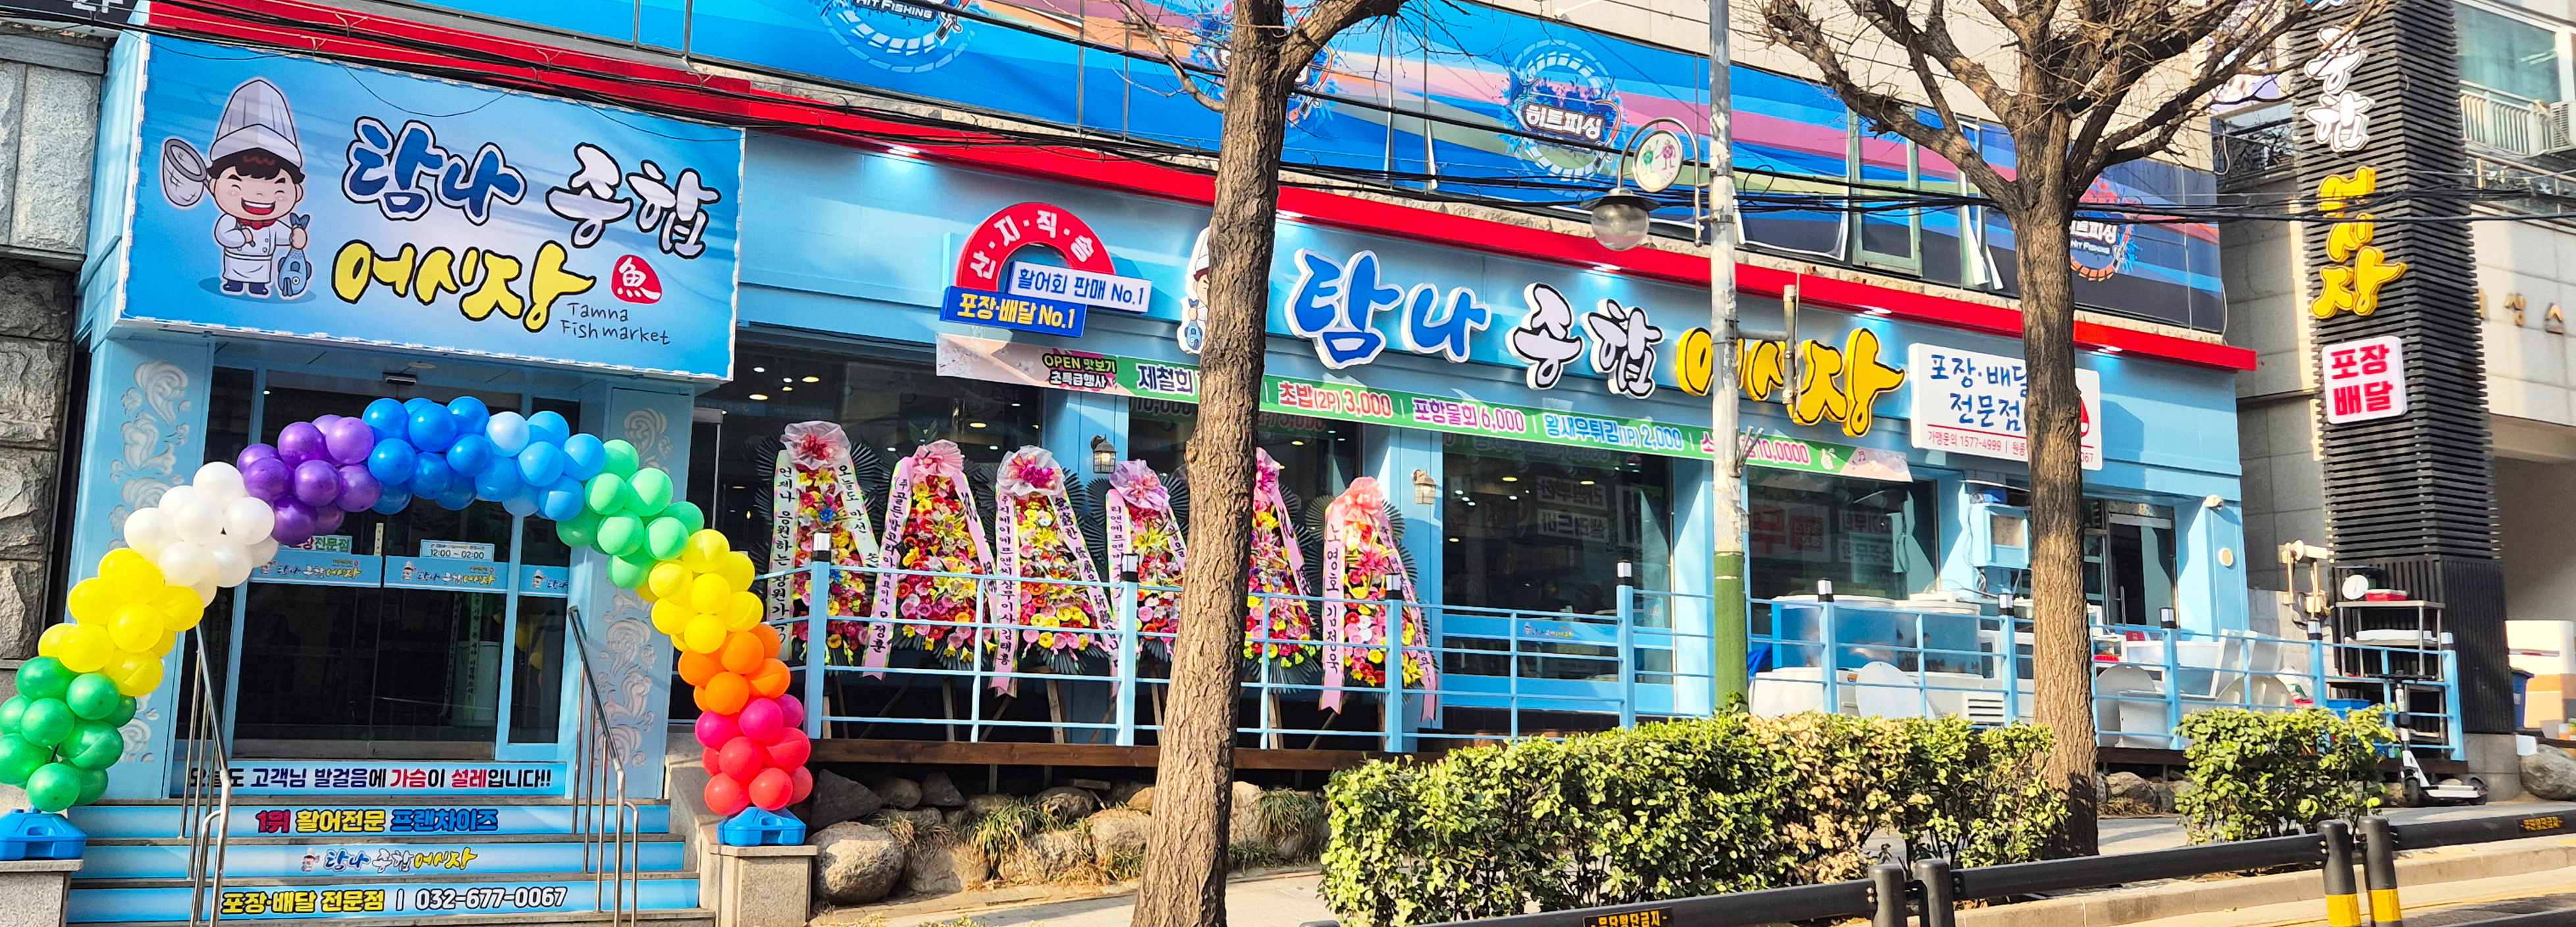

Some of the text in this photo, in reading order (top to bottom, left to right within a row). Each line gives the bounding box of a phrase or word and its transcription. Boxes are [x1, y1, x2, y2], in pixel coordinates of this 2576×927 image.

[881, 1, 932, 18] FISHING
[1525, 103, 1603, 140] 히트피싱
[342, 116, 722, 259] 탐나 종합
[2069, 219, 2118, 244] 트피싱
[332, 240, 597, 332] 어시장
[616, 257, 662, 302] 魚
[1017, 269, 1144, 305] 활어회 판매 No.1
[566, 303, 630, 322] Tamna
[957, 293, 1076, 329] 포장·배달 No.1
[1285, 248, 1491, 370] 탐나
[1507, 282, 1664, 399] 종합
[1043, 354, 1117, 373] OPEN 맛보기
[1050, 371, 1108, 388] 초특급행사
[2330, 343, 2391, 381] 포장
[1137, 364, 1194, 395] 제철회
[1345, 387, 1393, 419] 3,000
[1413, 398, 1478, 428] 포항물회
[1481, 407, 1526, 434] 6,000
[1642, 425, 1683, 451] 2,000
[1949, 392, 2022, 432] 전문점
[2332, 380, 2394, 417] 배달
[1927, 431, 1958, 447] 가맹문의
[1960, 435, 2002, 452] 1577-4999
[777, 466, 796, 503] 언제나
[837, 464, 859, 502] 오늘도
[430, 548, 451, 558] 12:00
[461, 550, 485, 560] 02:00
[776, 510, 793, 566] 응원하는
[250, 768, 307, 788] 고객님
[313, 768, 387, 788] 발걸음에
[390, 768, 445, 788] 가슴이
[451, 768, 551, 788] 설레입니다!!
[255, 808, 498, 834] 1위 활어전문 프랜차이즈
[323, 848, 371, 872] 탐나
[414, 847, 478, 870] 어시장
[221, 886, 568, 914] 포장·배달 전문점 032-677-0067
